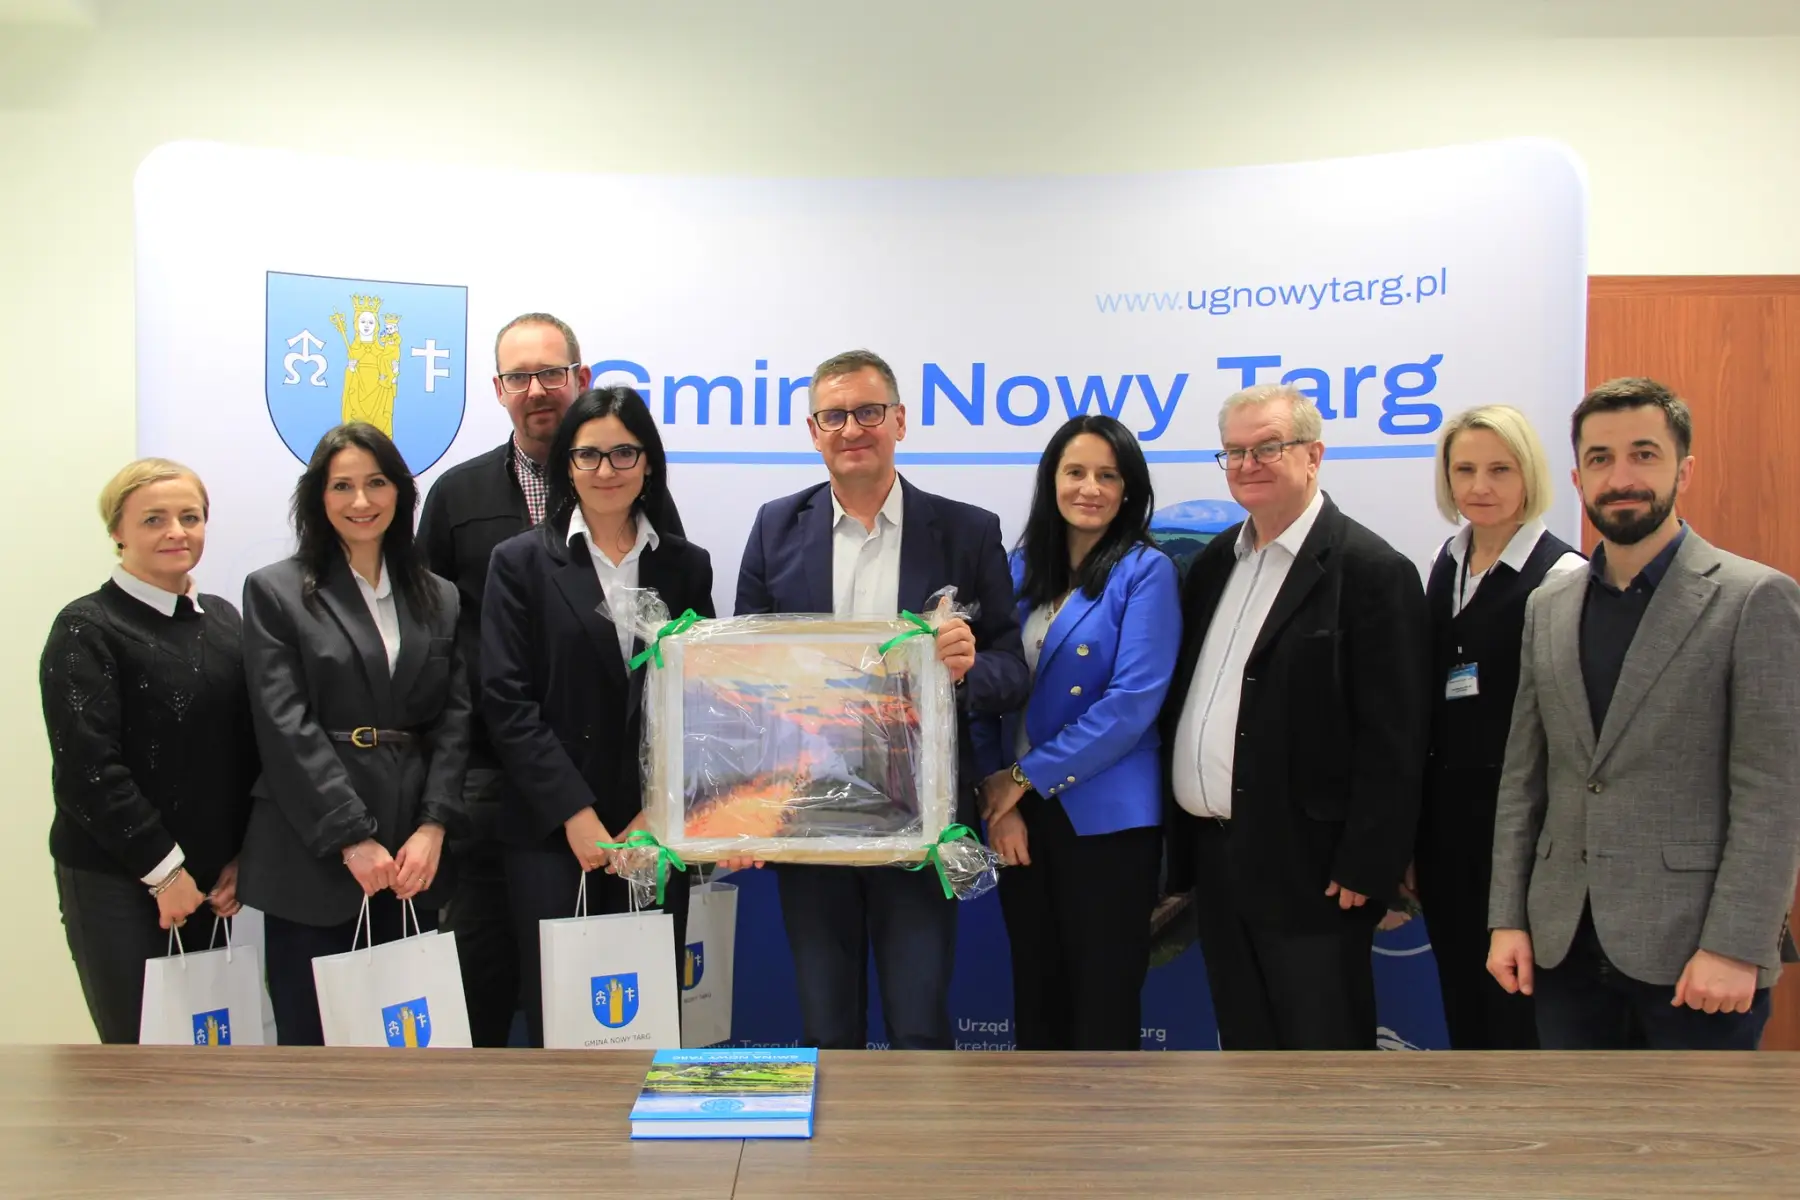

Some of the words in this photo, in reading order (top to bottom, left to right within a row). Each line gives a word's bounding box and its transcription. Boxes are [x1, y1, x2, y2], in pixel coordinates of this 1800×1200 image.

[1096, 267, 1447, 315] www.ugnowytarg.pl
[590, 359, 813, 426] Gmin
[921, 362, 1190, 442] Nowy
[1216, 354, 1444, 435] Targ
[958, 1018, 1009, 1036] Urząd
[1140, 1027, 1166, 1042] arg
[584, 1037, 608, 1048] GMINA
[610, 1035, 631, 1044] NOWY
[632, 1032, 652, 1042] TARG
